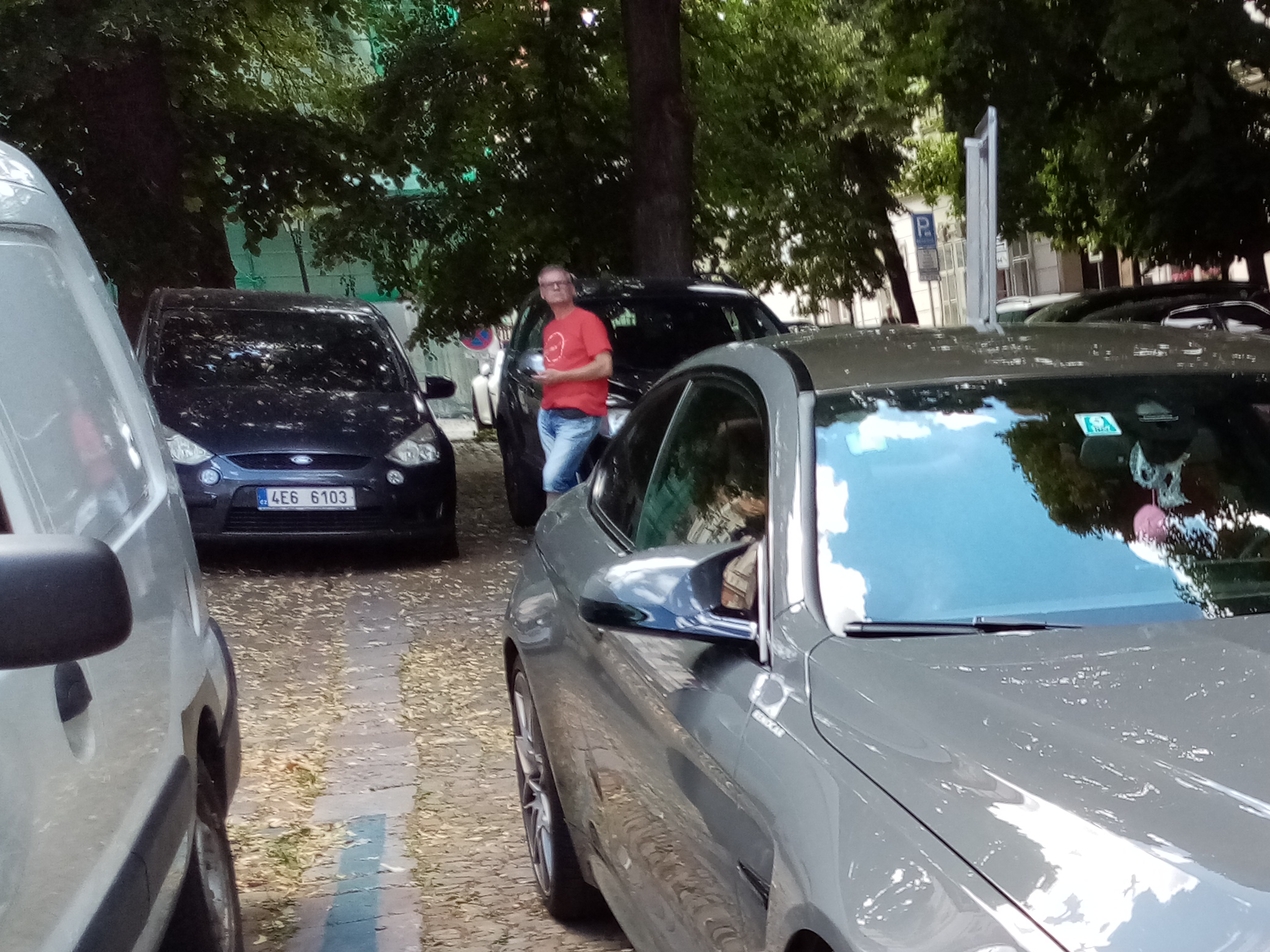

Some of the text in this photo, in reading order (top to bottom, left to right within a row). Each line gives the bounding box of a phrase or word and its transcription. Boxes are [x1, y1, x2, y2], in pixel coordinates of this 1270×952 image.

[916, 216, 930, 237] P
[272, 490, 347, 505] 4E6 6103
